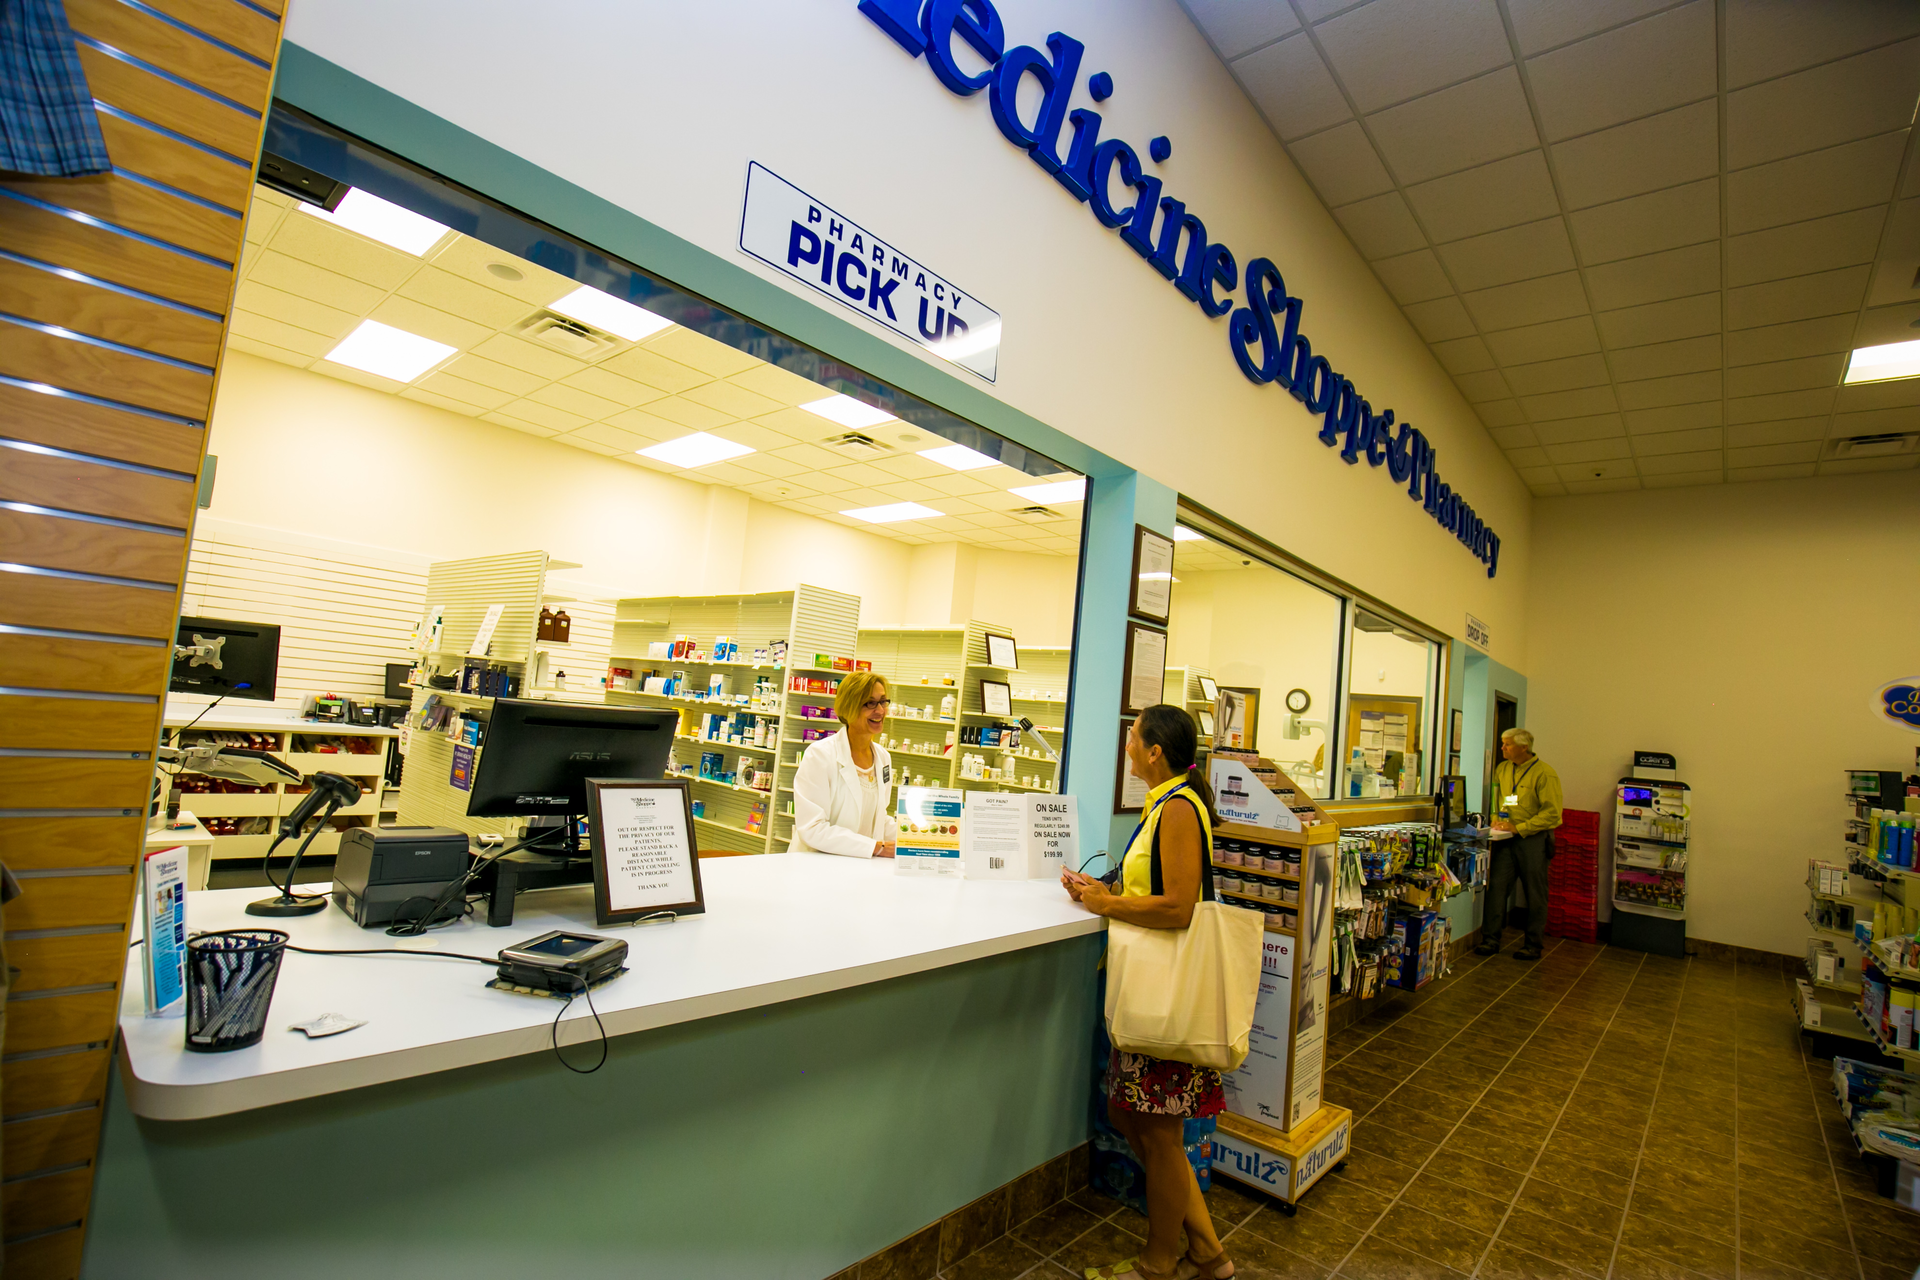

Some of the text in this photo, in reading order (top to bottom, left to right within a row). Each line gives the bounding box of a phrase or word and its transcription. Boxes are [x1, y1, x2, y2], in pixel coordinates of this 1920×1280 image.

[786, 219, 899, 322] PICK
[807, 204, 962, 311] PHARMACY
[858, 0, 1237, 318] edicine
[1408, 428, 1501, 579] Pharmacy
[1468, 624, 1489, 648] DROP OFF
[569, 752, 611, 760] ASUS
[1036, 804, 1067, 813] ON SALE
